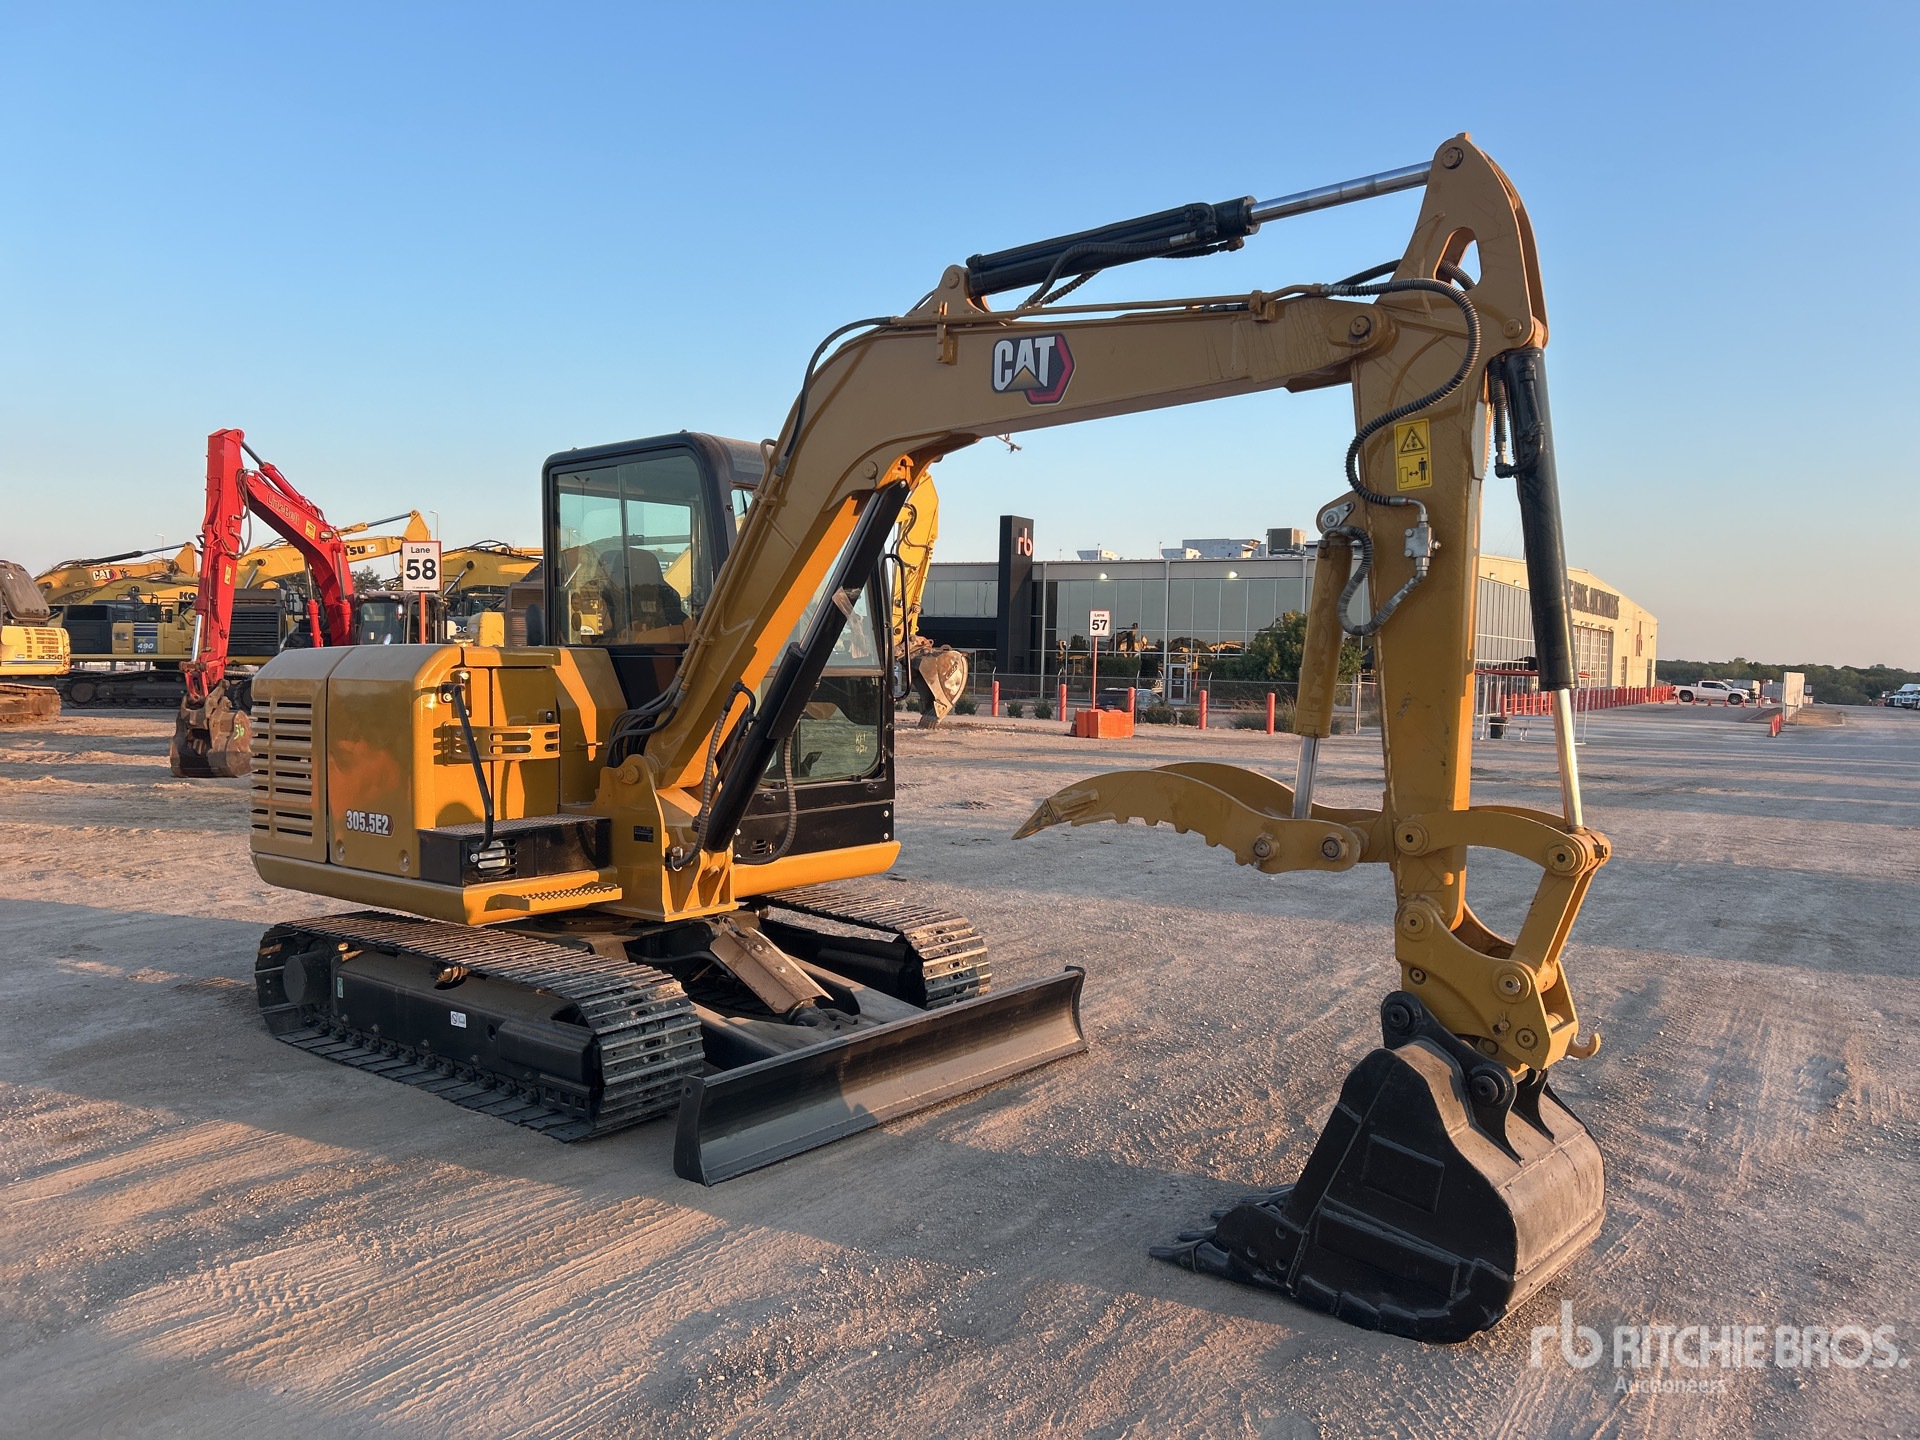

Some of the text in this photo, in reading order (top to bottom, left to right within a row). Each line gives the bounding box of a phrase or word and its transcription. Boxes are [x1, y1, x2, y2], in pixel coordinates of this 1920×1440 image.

[993, 336, 1056, 391] CAT
[1017, 527, 1033, 556] rb
[92, 569, 111, 581] CAT
[405, 558, 437, 580] 58
[1092, 619, 1108, 631] 57
[346, 809, 389, 835] 305.5E2
